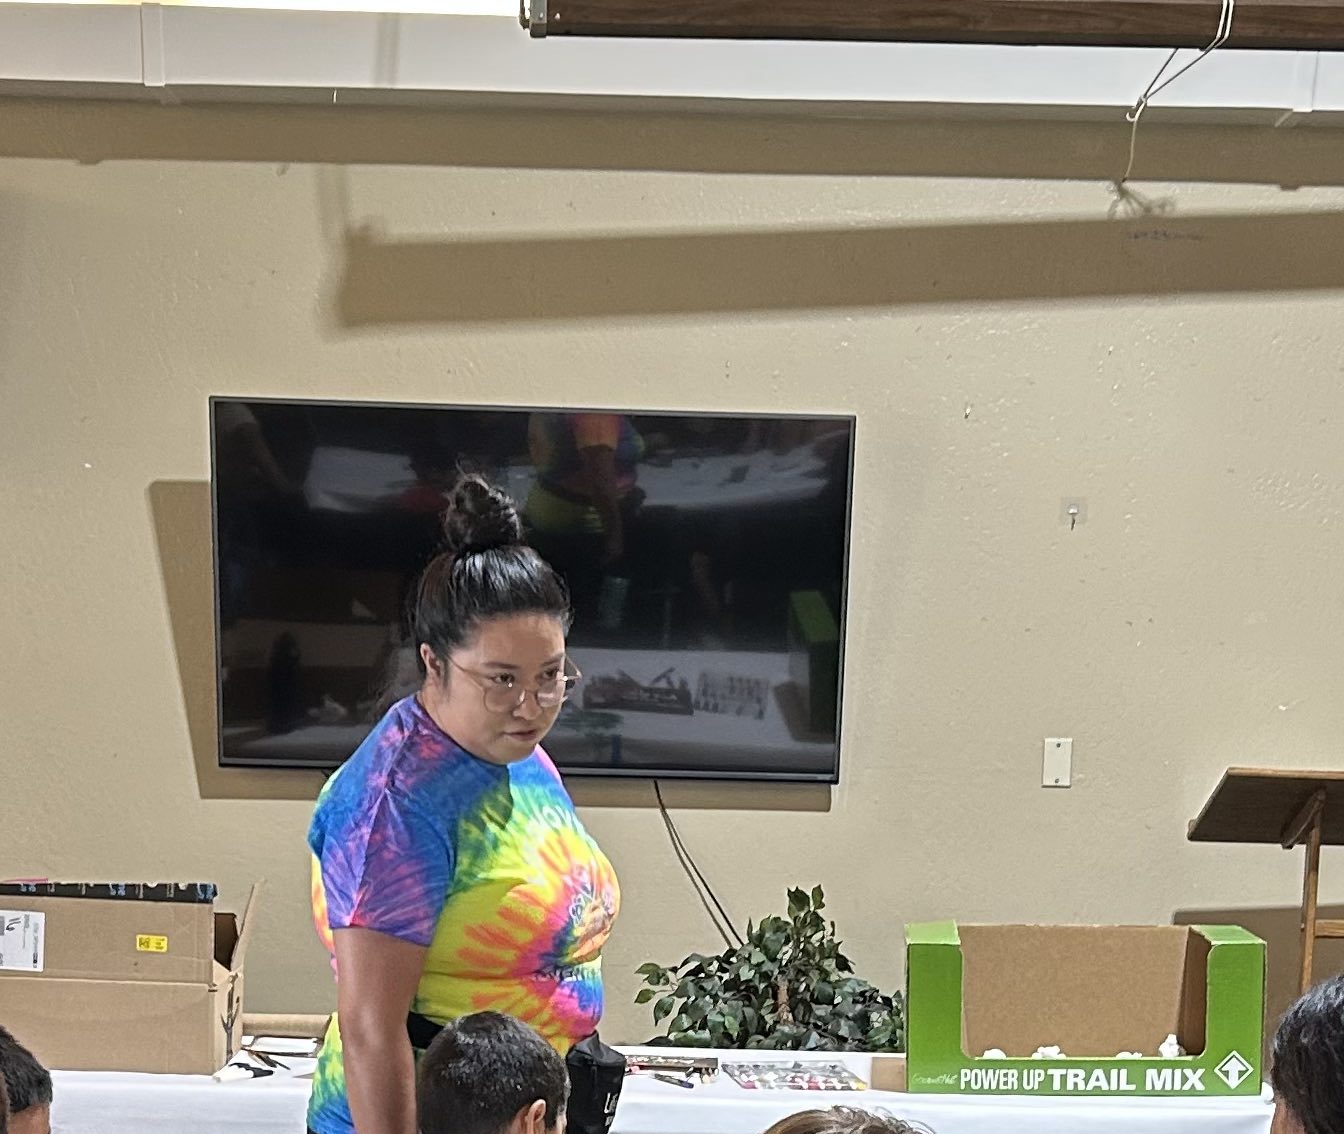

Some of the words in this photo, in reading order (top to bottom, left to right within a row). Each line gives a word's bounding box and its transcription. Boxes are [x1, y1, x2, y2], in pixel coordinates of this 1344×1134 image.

[960, 1068, 1018, 1090] POWER
[1023, 1068, 1045, 1090] UP
[1047, 1068, 1136, 1091] TRAIL
[1145, 1068, 1206, 1091] MIX
